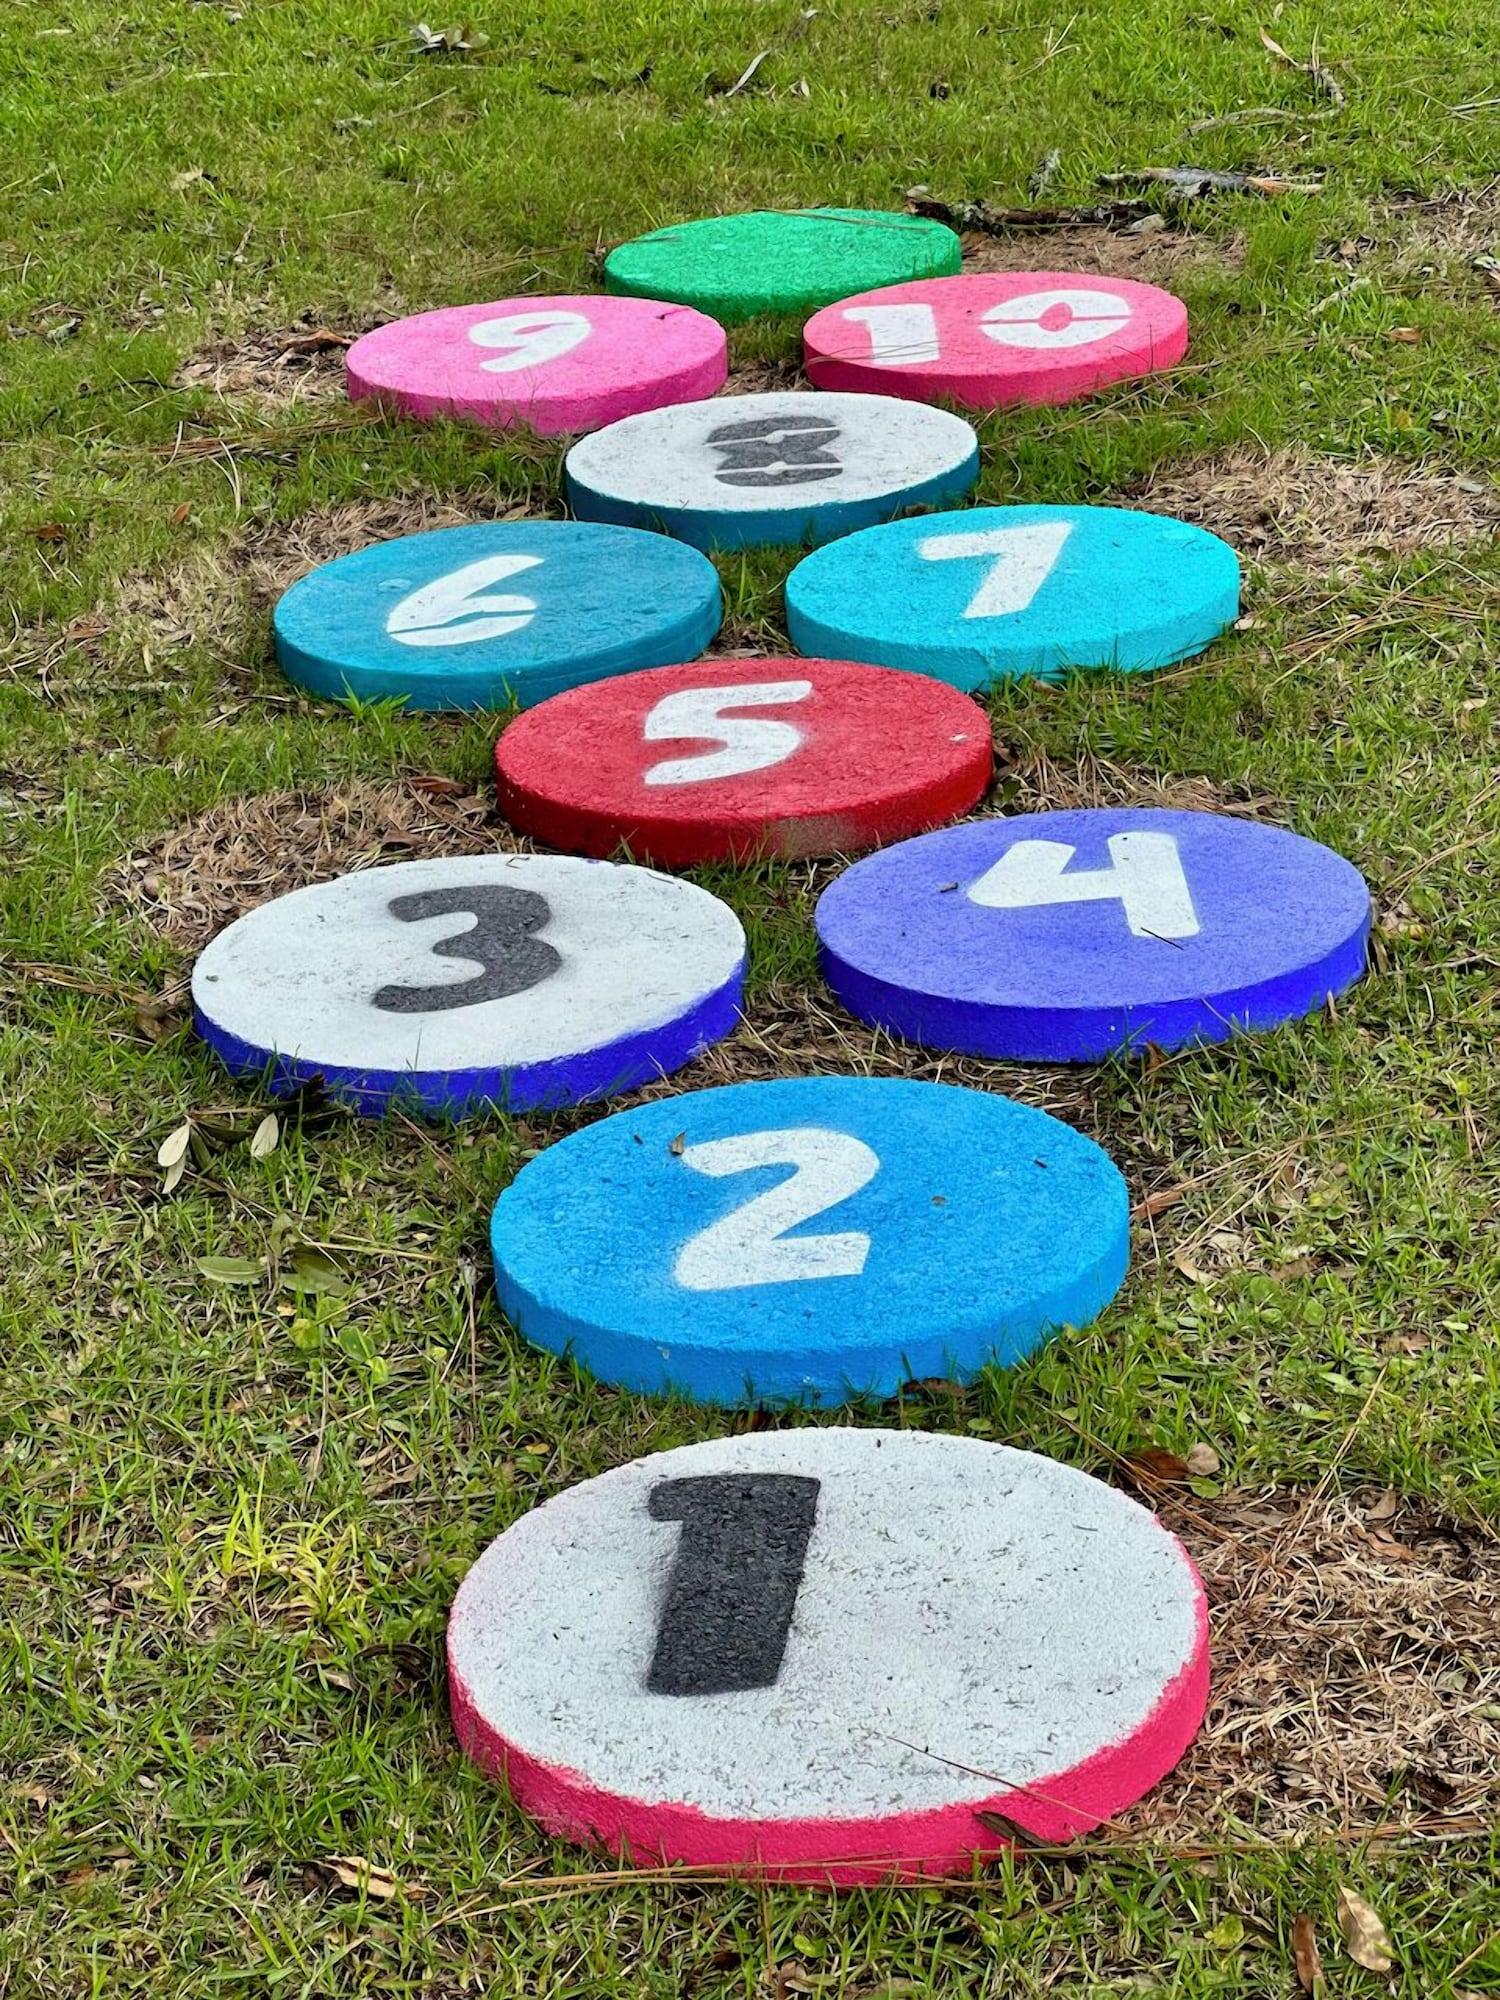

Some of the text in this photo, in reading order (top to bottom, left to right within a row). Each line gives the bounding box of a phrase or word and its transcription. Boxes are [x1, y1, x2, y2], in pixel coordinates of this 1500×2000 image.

[469, 313, 592, 372] 9
[842, 290, 1132, 365] 10
[706, 418, 844, 486] 8
[386, 555, 544, 647] 6
[919, 522, 1071, 619] 7
[643, 680, 812, 785] 5
[969, 831, 1201, 938] 4
[374, 886, 562, 1012] 3
[674, 1127, 881, 1291] 2
[648, 1475, 822, 1695] 1
